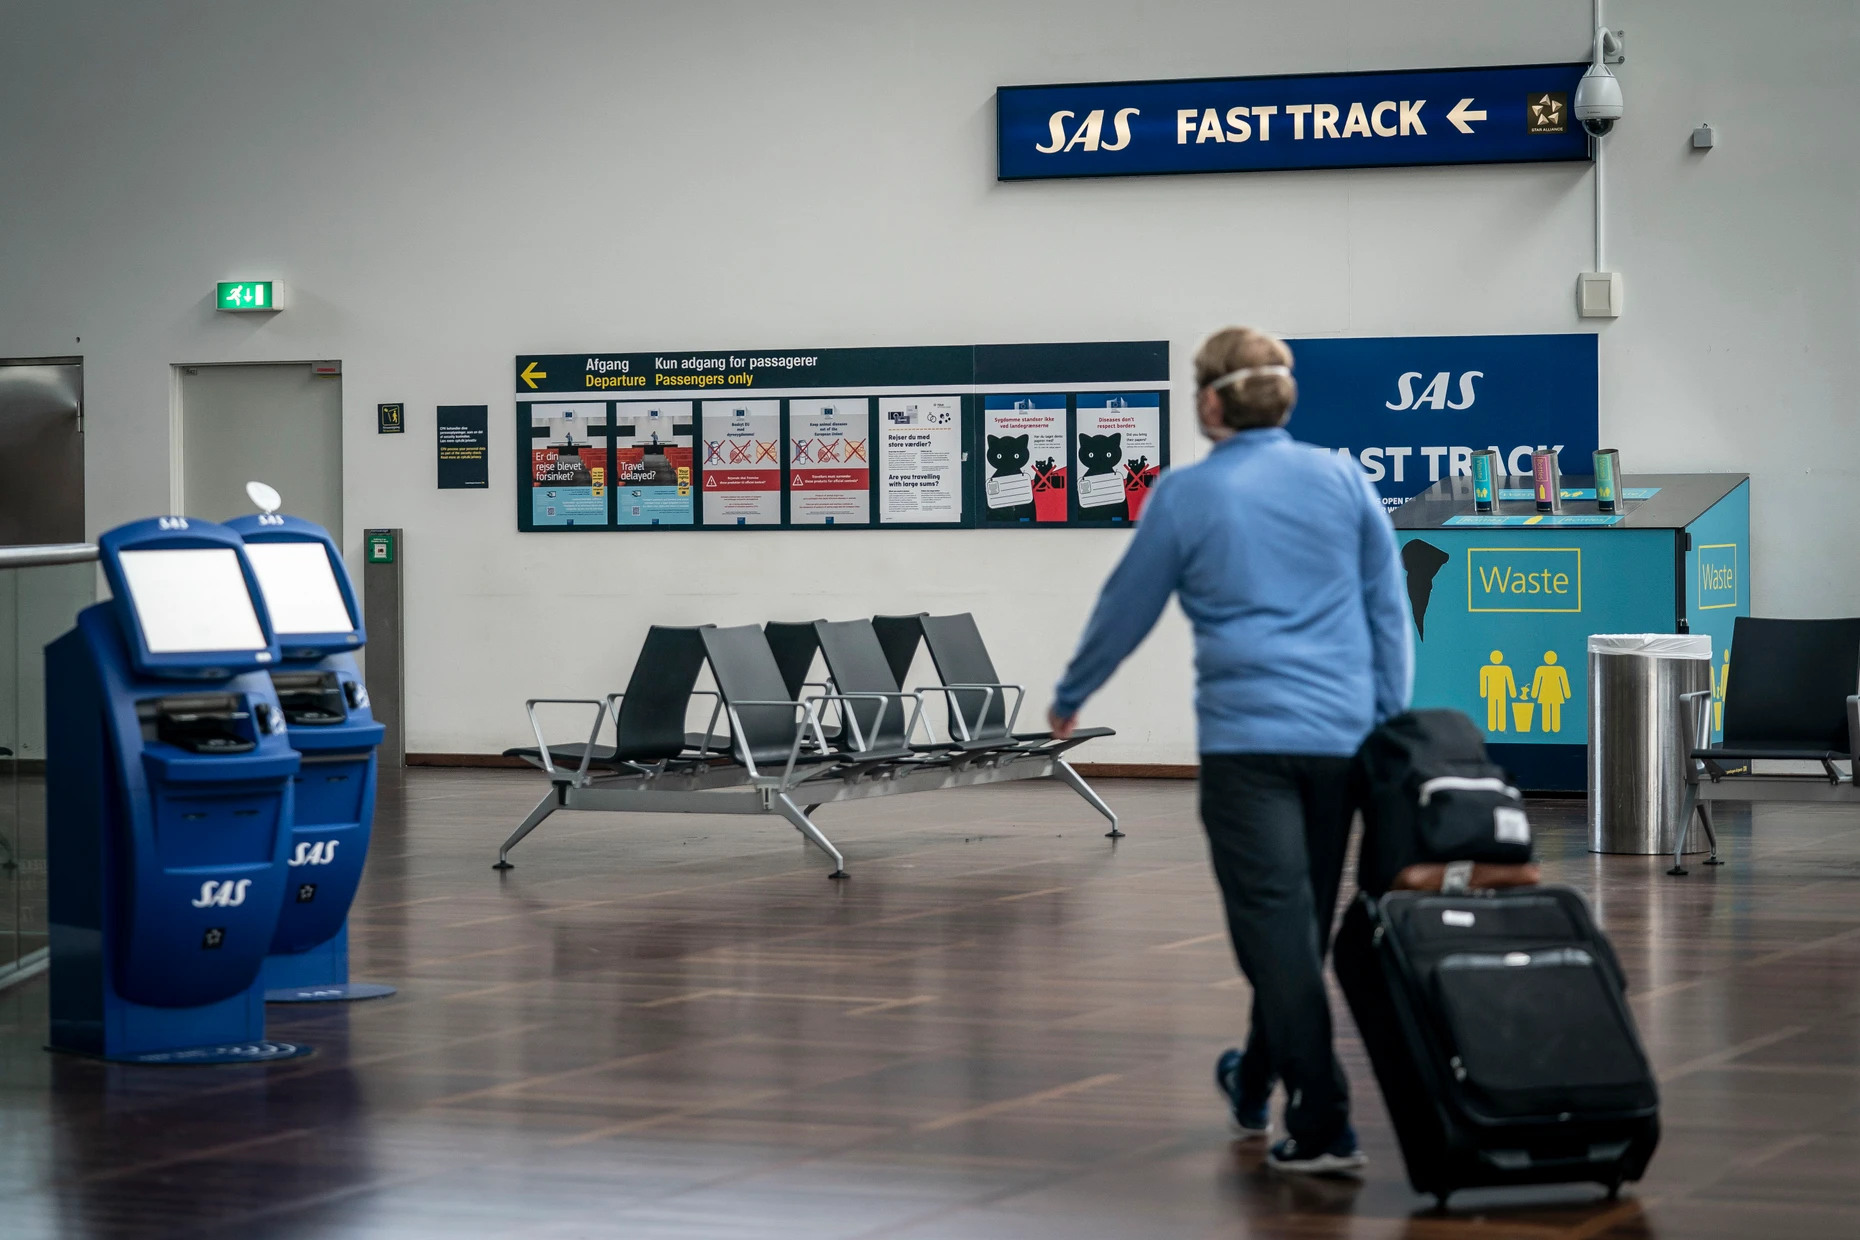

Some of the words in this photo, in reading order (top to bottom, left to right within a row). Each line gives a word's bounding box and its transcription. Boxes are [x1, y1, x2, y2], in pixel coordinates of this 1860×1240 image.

[1036, 107, 1140, 154] SAS
[1177, 106, 1278, 144] FAST
[1286, 100, 1428, 140] TRACK
[586, 358, 629, 373] Afgang
[655, 358, 678, 370] Kun
[681, 356, 726, 370] adgang
[730, 356, 746, 368] for
[750, 356, 818, 370] passagerer
[586, 374, 646, 389] Departure
[655, 373, 724, 387] Passengers
[728, 372, 753, 386] only
[1386, 371, 1483, 411] SAS
[536, 452, 544, 460] Er
[546, 452, 558, 460] din
[536, 462, 554, 472] rejse
[557, 462, 582, 470] blevet
[621, 461, 644, 470] Travel
[536, 472, 574, 480] forsinket?
[620, 471, 656, 481] delayed?
[258, 514, 284, 526] SAS
[1479, 566, 1569, 594] Waste
[1702, 562, 1732, 590] Waste
[287, 840, 340, 866] SAS
[192, 879, 252, 908] SAS
